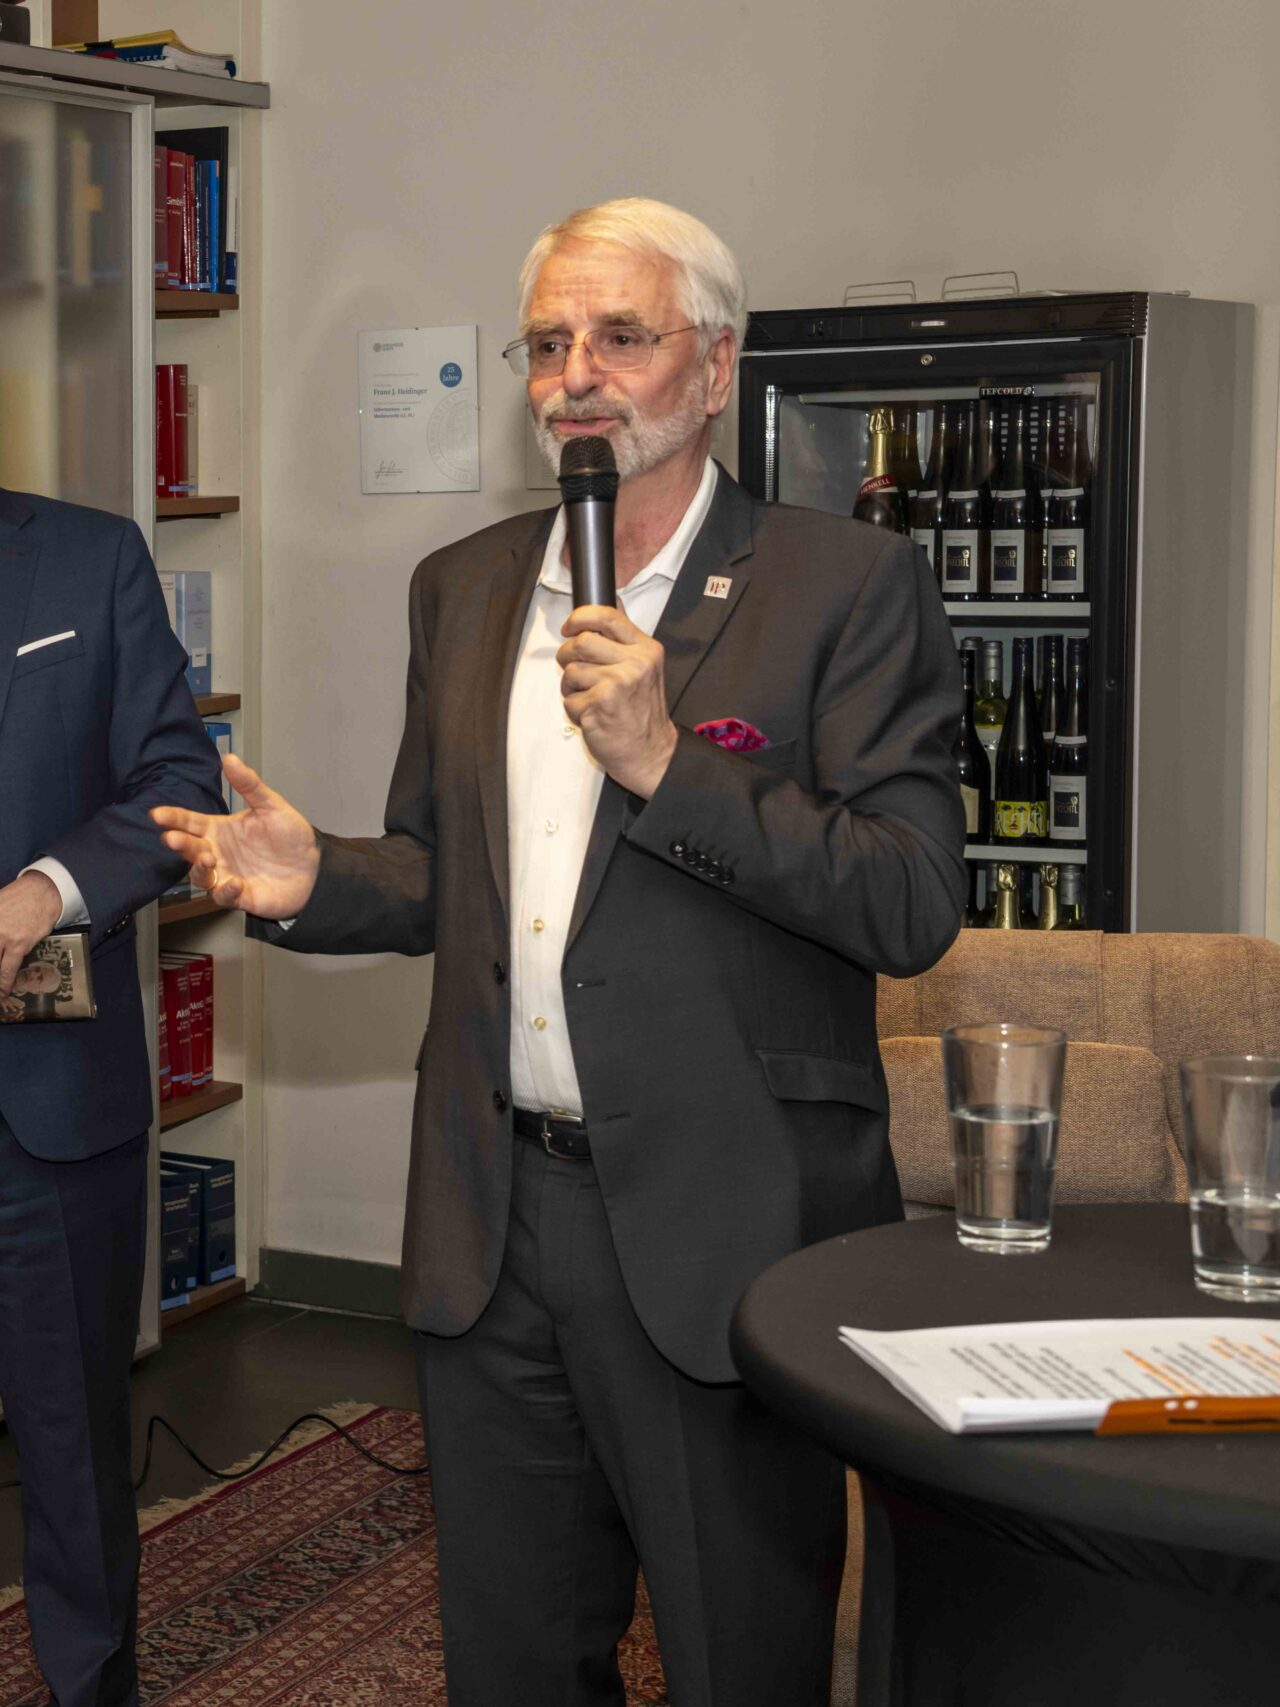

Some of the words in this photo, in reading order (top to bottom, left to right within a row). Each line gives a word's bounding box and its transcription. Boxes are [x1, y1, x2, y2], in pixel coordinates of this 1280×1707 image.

[442, 374, 460, 382] Jahre
[373, 388, 391, 396] Franz
[398, 387, 428, 397] Heidinger
[981, 387, 1023, 396] TEFCOLD
